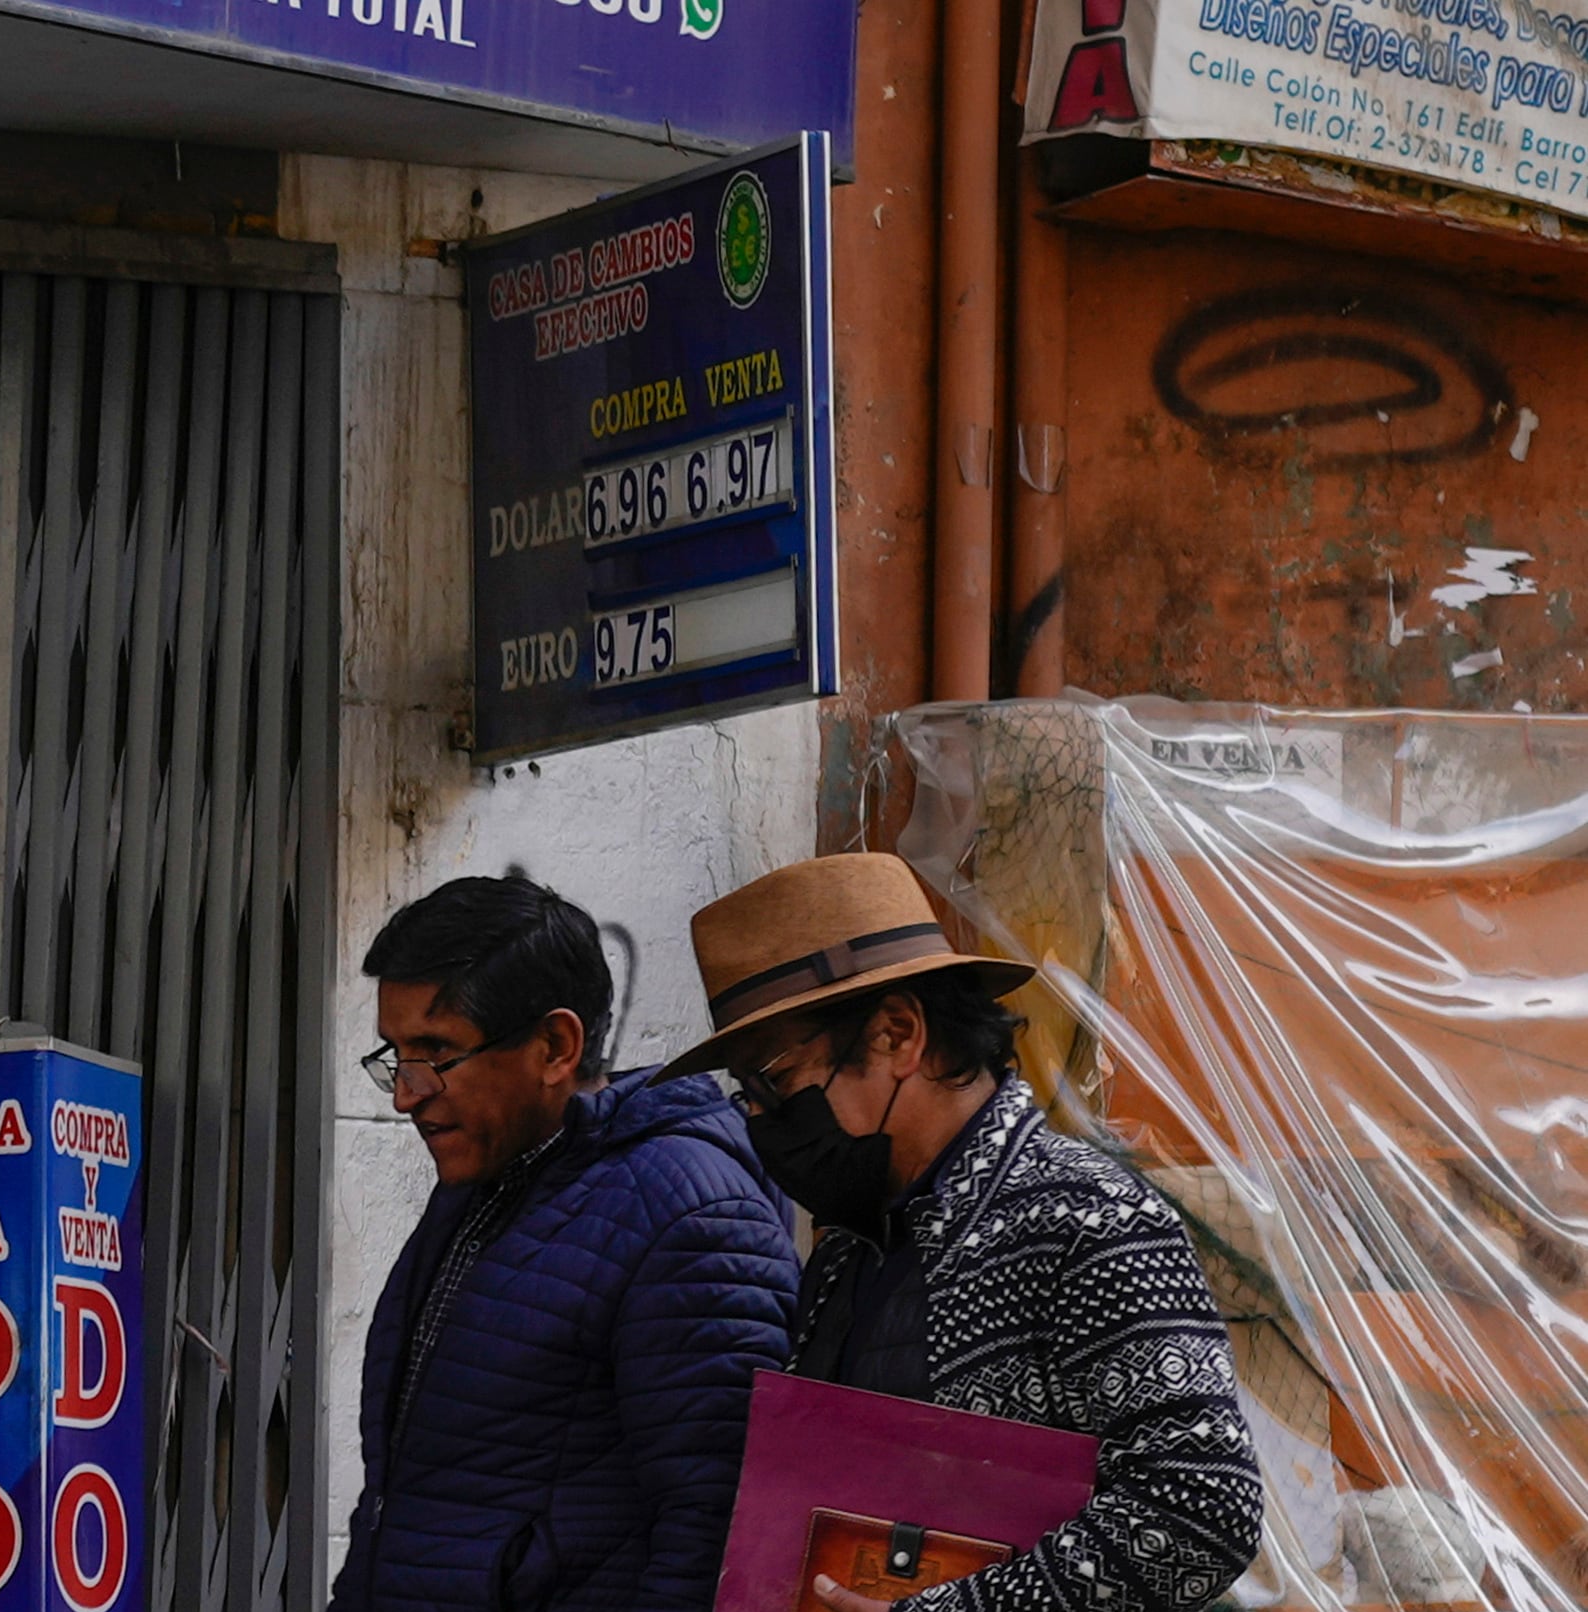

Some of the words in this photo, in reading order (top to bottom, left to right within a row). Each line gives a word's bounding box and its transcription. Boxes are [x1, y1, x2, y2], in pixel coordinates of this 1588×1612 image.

[1189, 51, 1256, 88] Calle
[1267, 68, 1341, 107] Colón
[1353, 87, 1392, 119] No.
[1405, 100, 1445, 132] 161
[1457, 113, 1509, 148] Edif.
[1324, 7, 1492, 94] Especiales
[1492, 56, 1576, 118] para
[1372, 130, 1486, 174] 2-373178
[1515, 161, 1559, 191] Cel
[489, 257, 546, 321] CASA
[552, 246, 585, 303] DE
[588, 213, 695, 288] CAMBIOS
[535, 286, 649, 360] EFECTIVO
[590, 377, 687, 439] COMPRA
[705, 349, 784, 408] VENTA
[490, 487, 583, 559] DOLAR
[587, 458, 670, 542] 6.96
[686, 430, 776, 515] 6.97
[501, 625, 578, 692] EURO
[596, 604, 674, 683] 9.75
[1150, 738, 1190, 763] EN
[1201, 741, 1306, 770] VENTA
[52, 1102, 129, 1164] COMPRA
[82, 1165, 101, 1207] Y
[60, 1210, 121, 1268] VENTA
